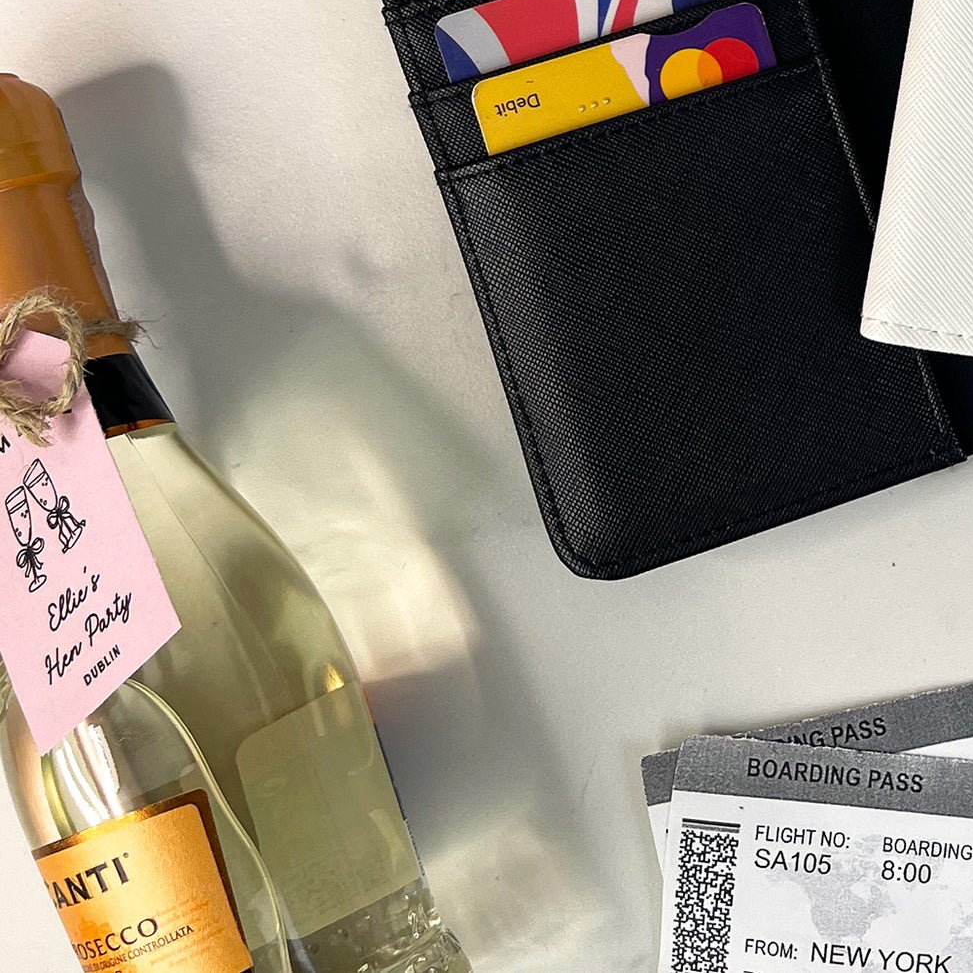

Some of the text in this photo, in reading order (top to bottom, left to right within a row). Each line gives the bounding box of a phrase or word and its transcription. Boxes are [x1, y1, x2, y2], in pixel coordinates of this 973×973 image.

[494, 93, 541, 117] Debit
[47, 565, 100, 632] Ellie's
[44, 591, 132, 685] Hen Party
[83, 644, 121, 687] DUBLIN
[831, 717, 887, 747] PASS
[746, 756, 924, 794] BOARDING PASS
[754, 824, 851, 849] FLIGHT NO:
[882, 836, 973, 861] BOARDING
[754, 848, 832, 875] SA105
[880, 859, 932, 884] 8:00
[44, 856, 130, 911] ANTI
[127, 925, 194, 961] CONTROLLATA
[744, 938, 952, 973] FROM: NEW YORK
